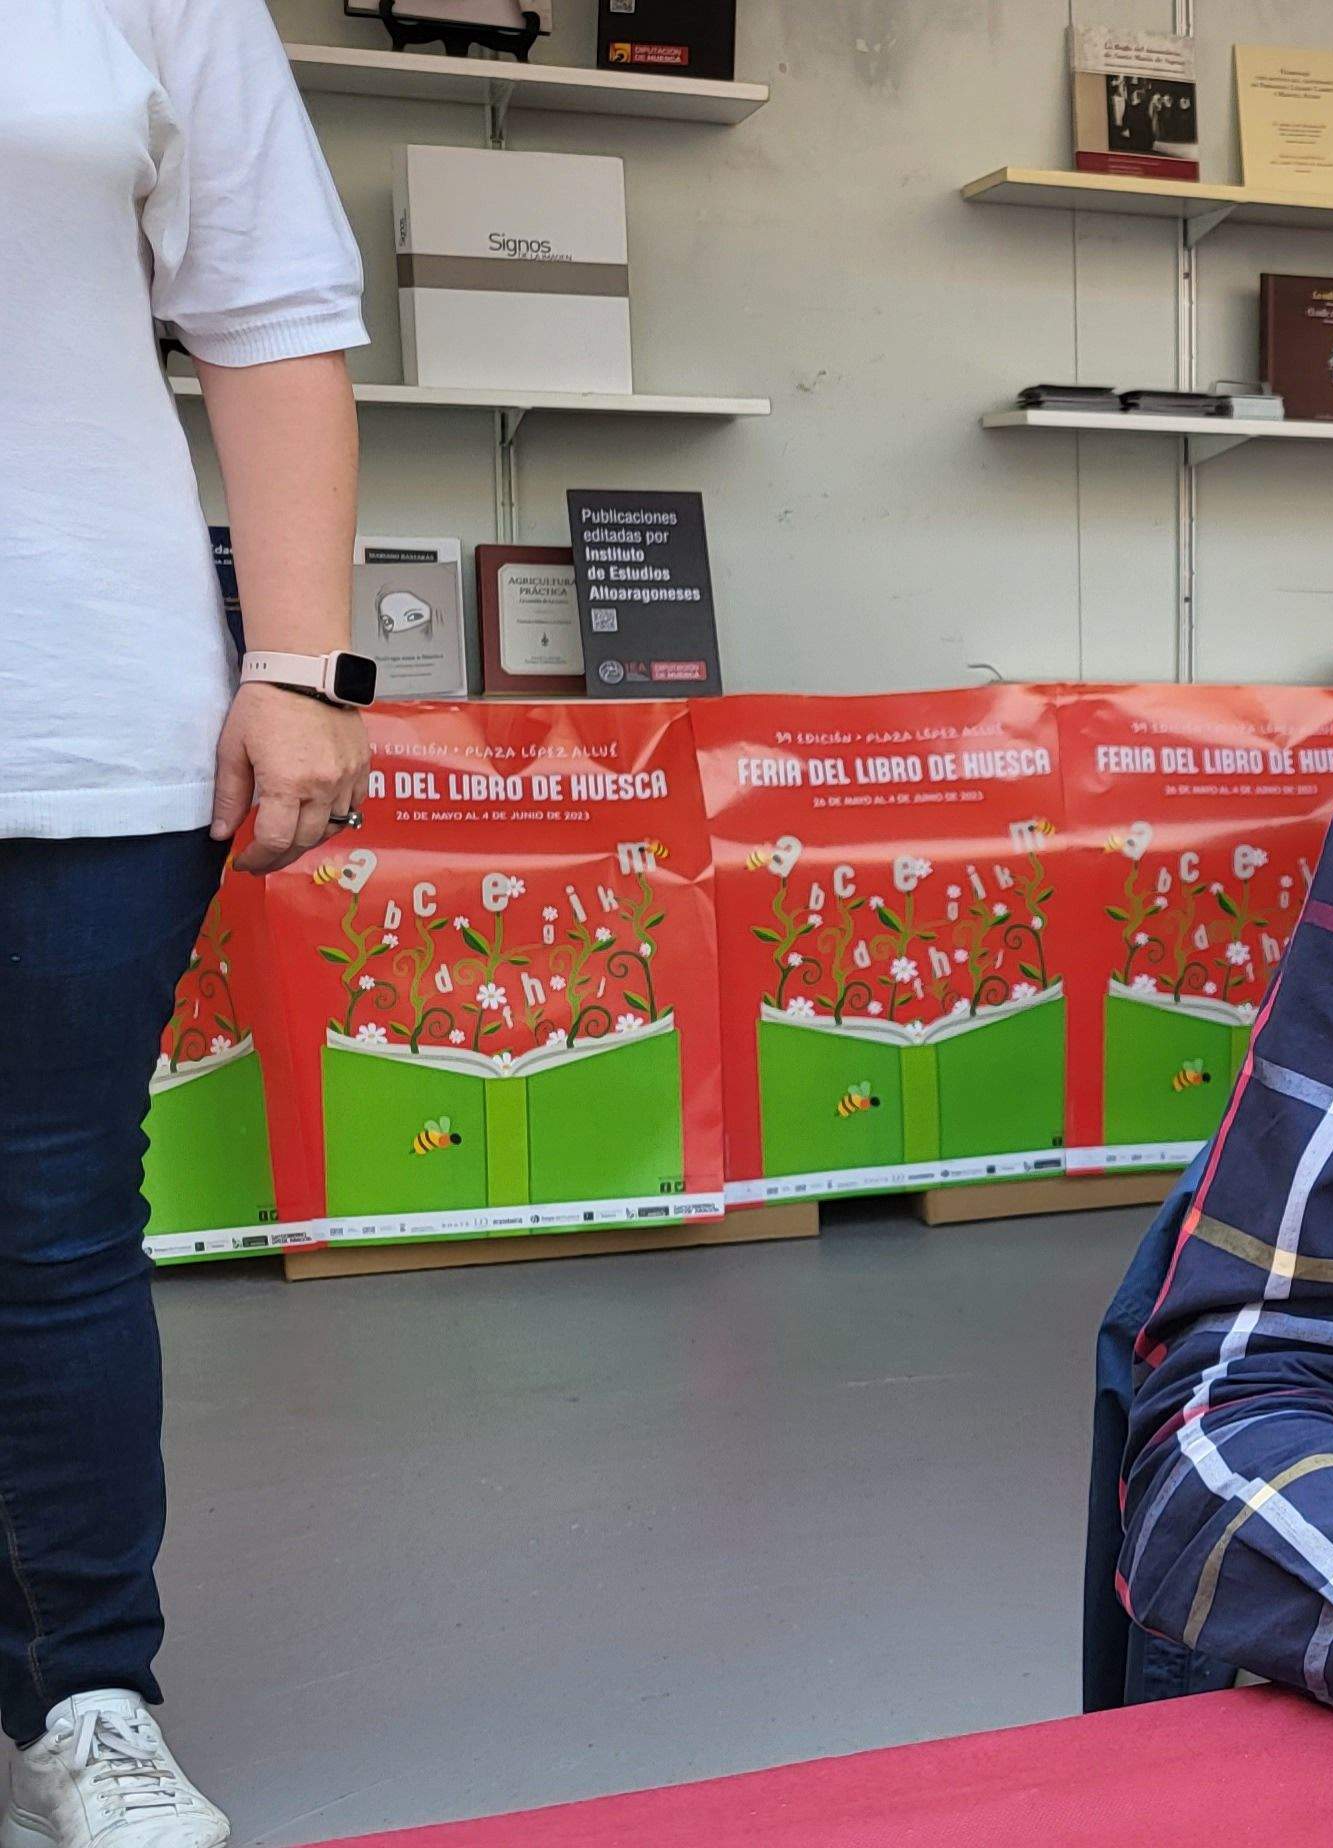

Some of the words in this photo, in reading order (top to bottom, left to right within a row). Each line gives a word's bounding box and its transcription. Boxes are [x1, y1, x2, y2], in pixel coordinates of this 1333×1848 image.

[488, 232, 551, 257] Signos
[581, 508, 678, 526] Publicaciones
[583, 528, 642, 543] editadas
[645, 531, 669, 546] por
[585, 547, 645, 562] Instituto
[587, 566, 606, 581] de
[609, 566, 670, 581] Estudios
[589, 585, 701, 604] Altoaragoneses
[865, 730, 913, 744] PLAZA
[369, 743, 378, 755] 9
[385, 743, 448, 756] EDICIÓN
[465, 746, 515, 759] PLAZA
[521, 745, 568, 758] LÓPEZ
[571, 741, 618, 758] ALLUÉ
[737, 758, 803, 788] FERIA
[807, 757, 850, 786] DEL
[855, 755, 923, 785] LIBRO
[928, 754, 958, 782] DE
[962, 748, 1051, 778] HUESCA
[1096, 745, 1156, 774] FERIA
[1161, 746, 1199, 775] DEL
[1203, 747, 1263, 775] LIBRO
[1267, 748, 1296, 775] DE
[395, 771, 440, 800] DEL
[448, 773, 524, 801] LIBRO
[531, 774, 563, 801] DE
[570, 769, 668, 801] HUESCA
[396, 811, 410, 821] 26
[413, 811, 429, 821] DE
[431, 811, 462, 821] MAYO
[465, 811, 480, 821] AL
[482, 811, 489, 821] 4
[492, 811, 507, 821] DE
[510, 811, 544, 821] JUNIO
[547, 811, 561, 821] DE
[563, 811, 590, 821] 2023
